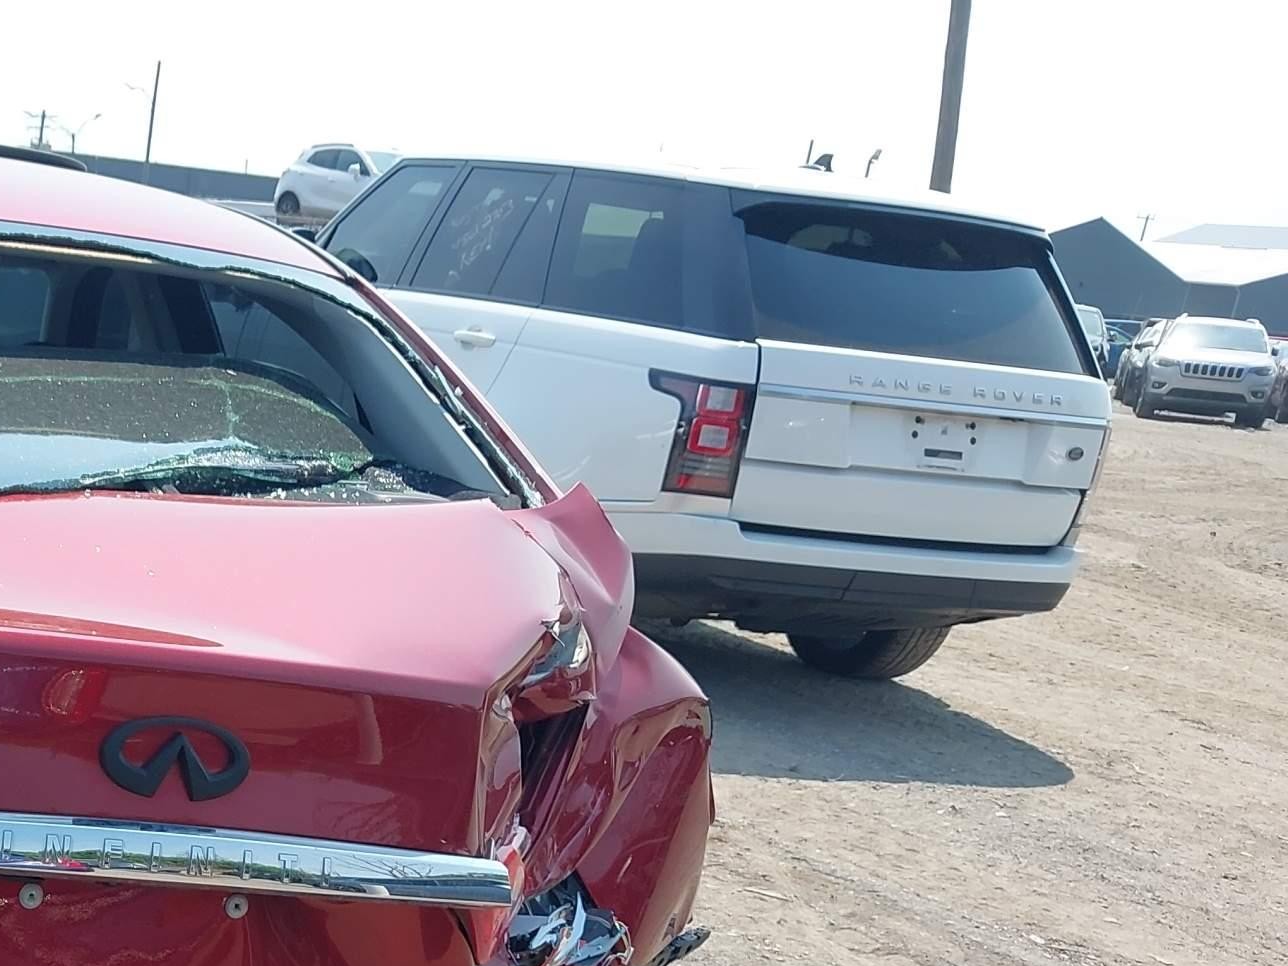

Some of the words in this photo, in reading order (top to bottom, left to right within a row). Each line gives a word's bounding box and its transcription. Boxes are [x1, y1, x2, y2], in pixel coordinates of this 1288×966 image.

[849, 374, 953, 396] RANGE
[973, 386, 1063, 407] ROVER
[1, 829, 332, 888] INFINITI
